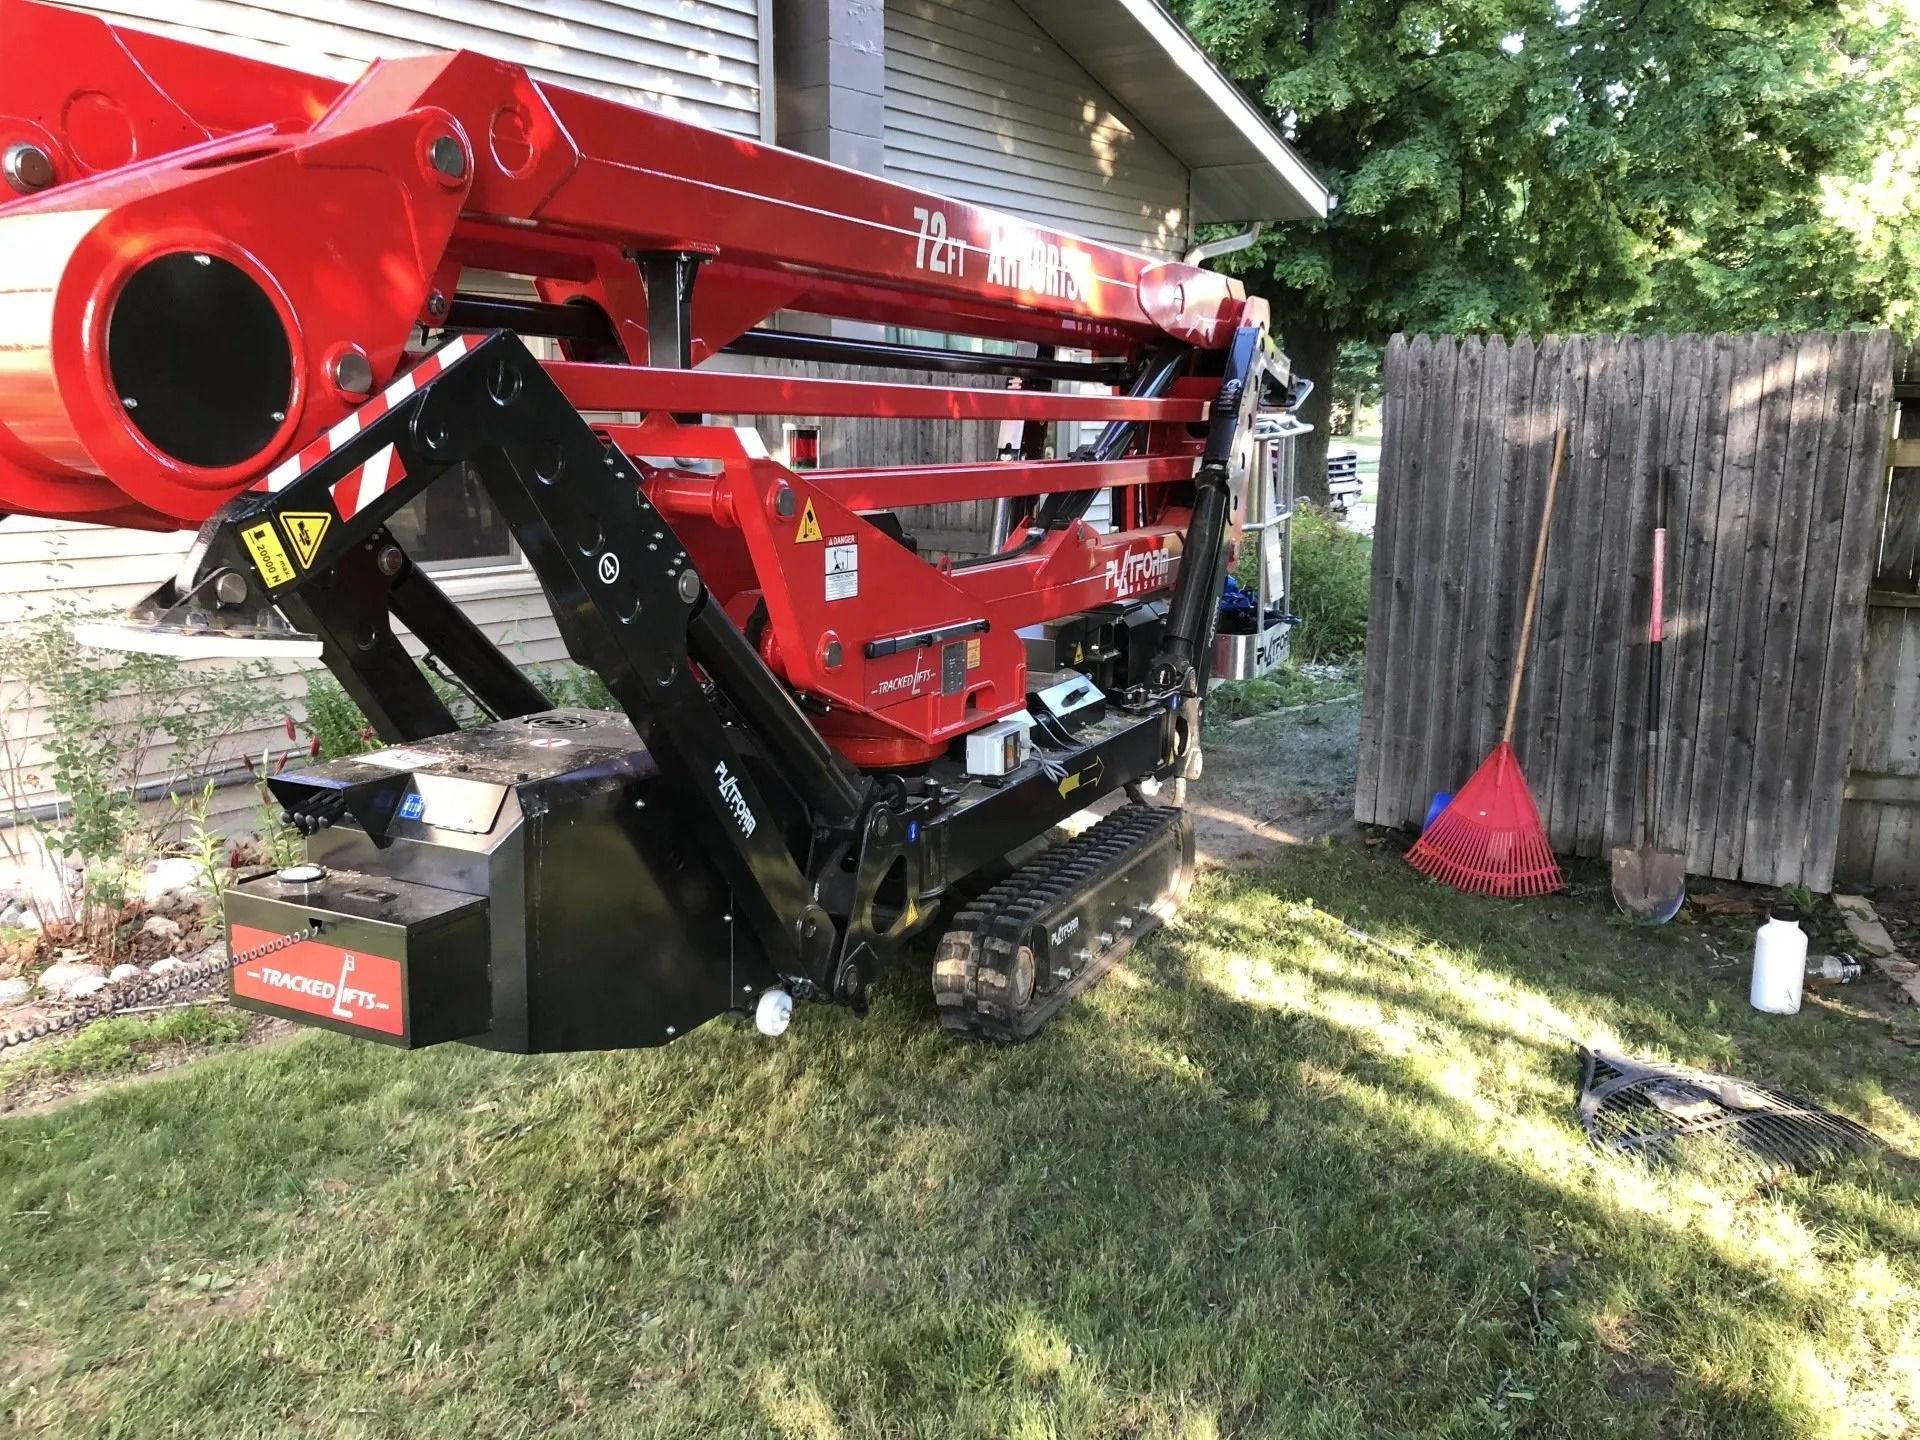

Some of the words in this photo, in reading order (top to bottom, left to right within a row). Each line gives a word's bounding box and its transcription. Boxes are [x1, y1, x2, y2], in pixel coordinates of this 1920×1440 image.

[833, 534, 856, 546] DANGER
[256, 544, 277, 573] 20000
[272, 575, 282, 583] N
[604, 558, 615, 577] 4
[1105, 544, 1169, 598] PLATFORM
[1129, 575, 1168, 594] BASKET
[879, 674, 914, 695] TRACKED
[714, 760, 757, 835] PLATFORM
[1051, 916, 1079, 946] PLATFORM
[261, 967, 336, 999] TRACKED
[332, 953, 376, 1018] LIFTS
